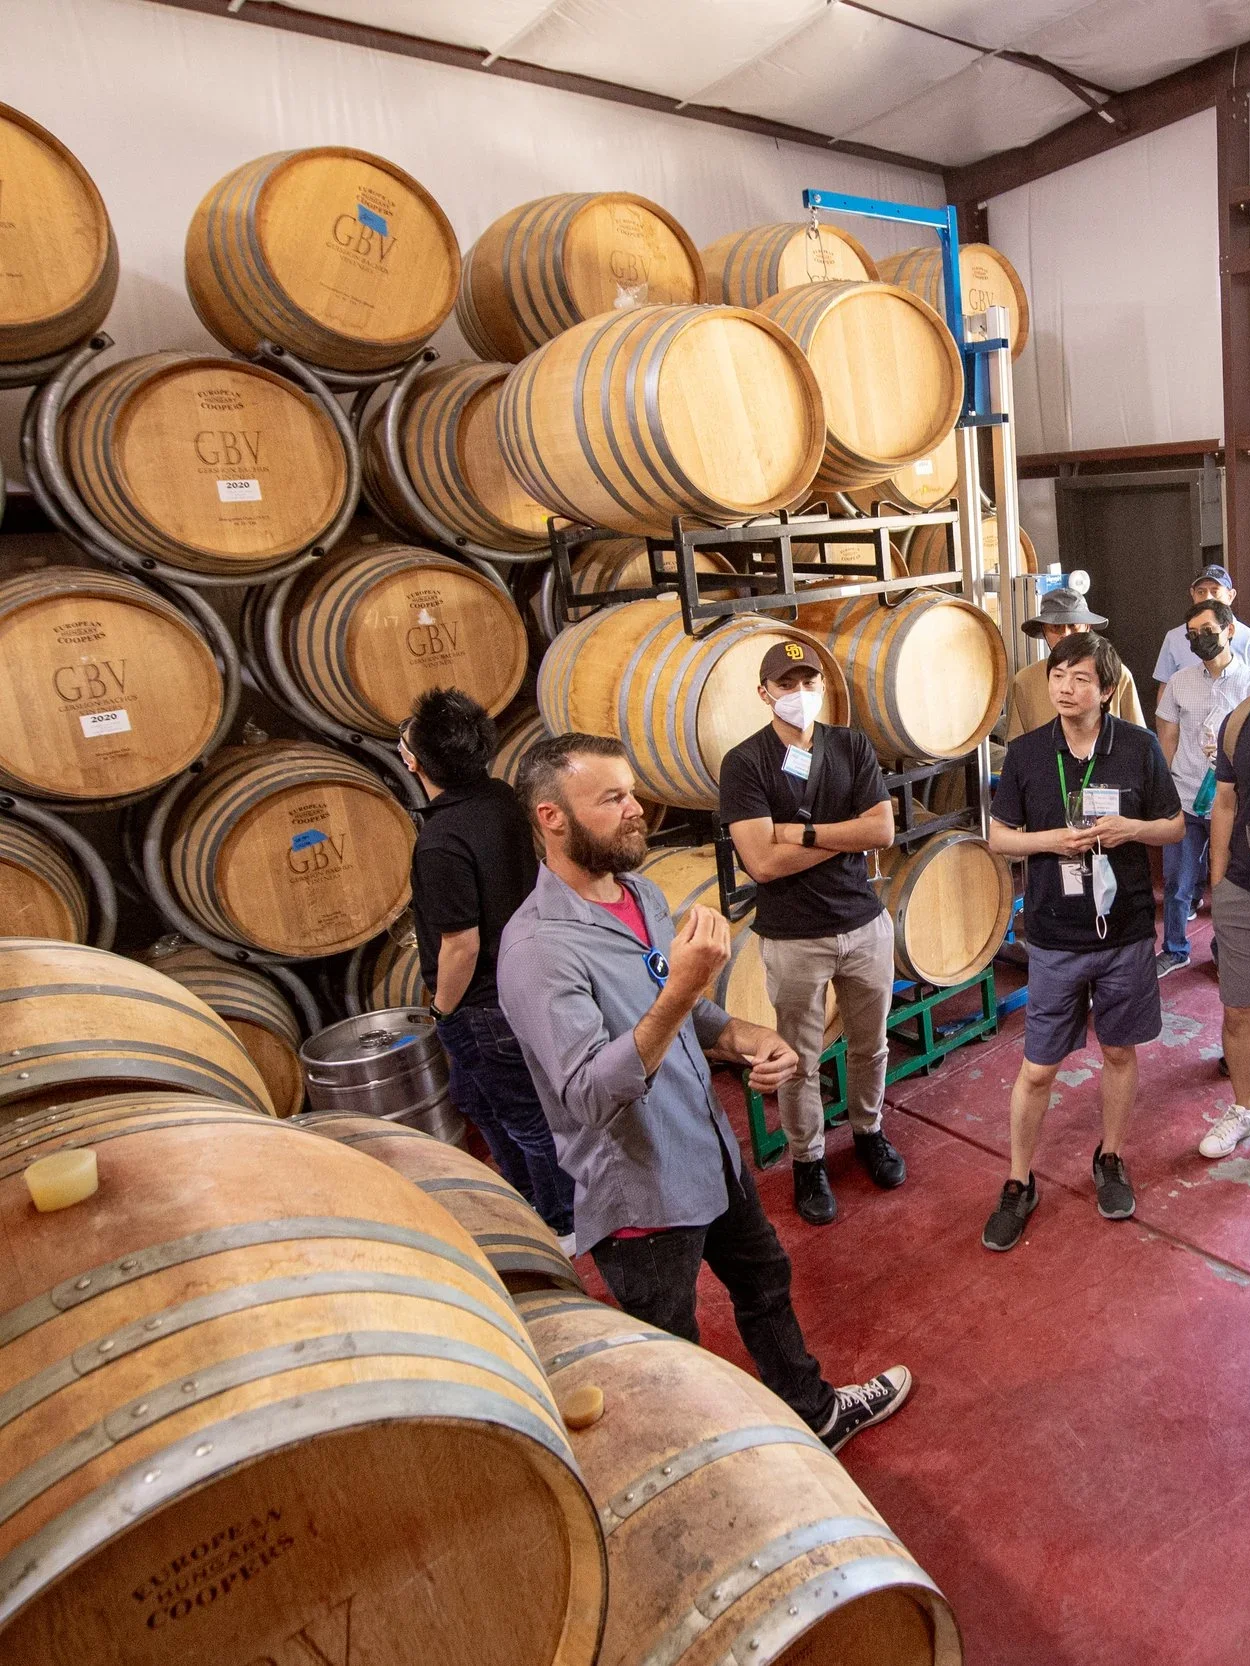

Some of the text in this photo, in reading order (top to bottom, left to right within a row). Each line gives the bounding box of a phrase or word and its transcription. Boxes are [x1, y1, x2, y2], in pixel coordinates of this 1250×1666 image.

[332, 213, 398, 262] GBV
[609, 249, 652, 282] GBV
[968, 288, 994, 312] GBV
[193, 430, 262, 466] GBV
[225, 481, 250, 489] 2020
[409, 599, 444, 609] COOPERS
[53, 620, 102, 633] EUROPEAN
[57, 632, 106, 644] COOPERS
[406, 621, 459, 657] GBV
[785, 643, 804, 660] SD
[52, 659, 128, 703] GBV
[90, 713, 117, 723] 2020
[288, 803, 327, 816] EUROPEAN
[292, 812, 330, 825] COOPERS
[287, 832, 346, 875] GBV
[131, 1506, 282, 1602] EUROPEAN
[156, 1530, 268, 1604] HUNGARY
[147, 1532, 296, 1630] COOPERS
